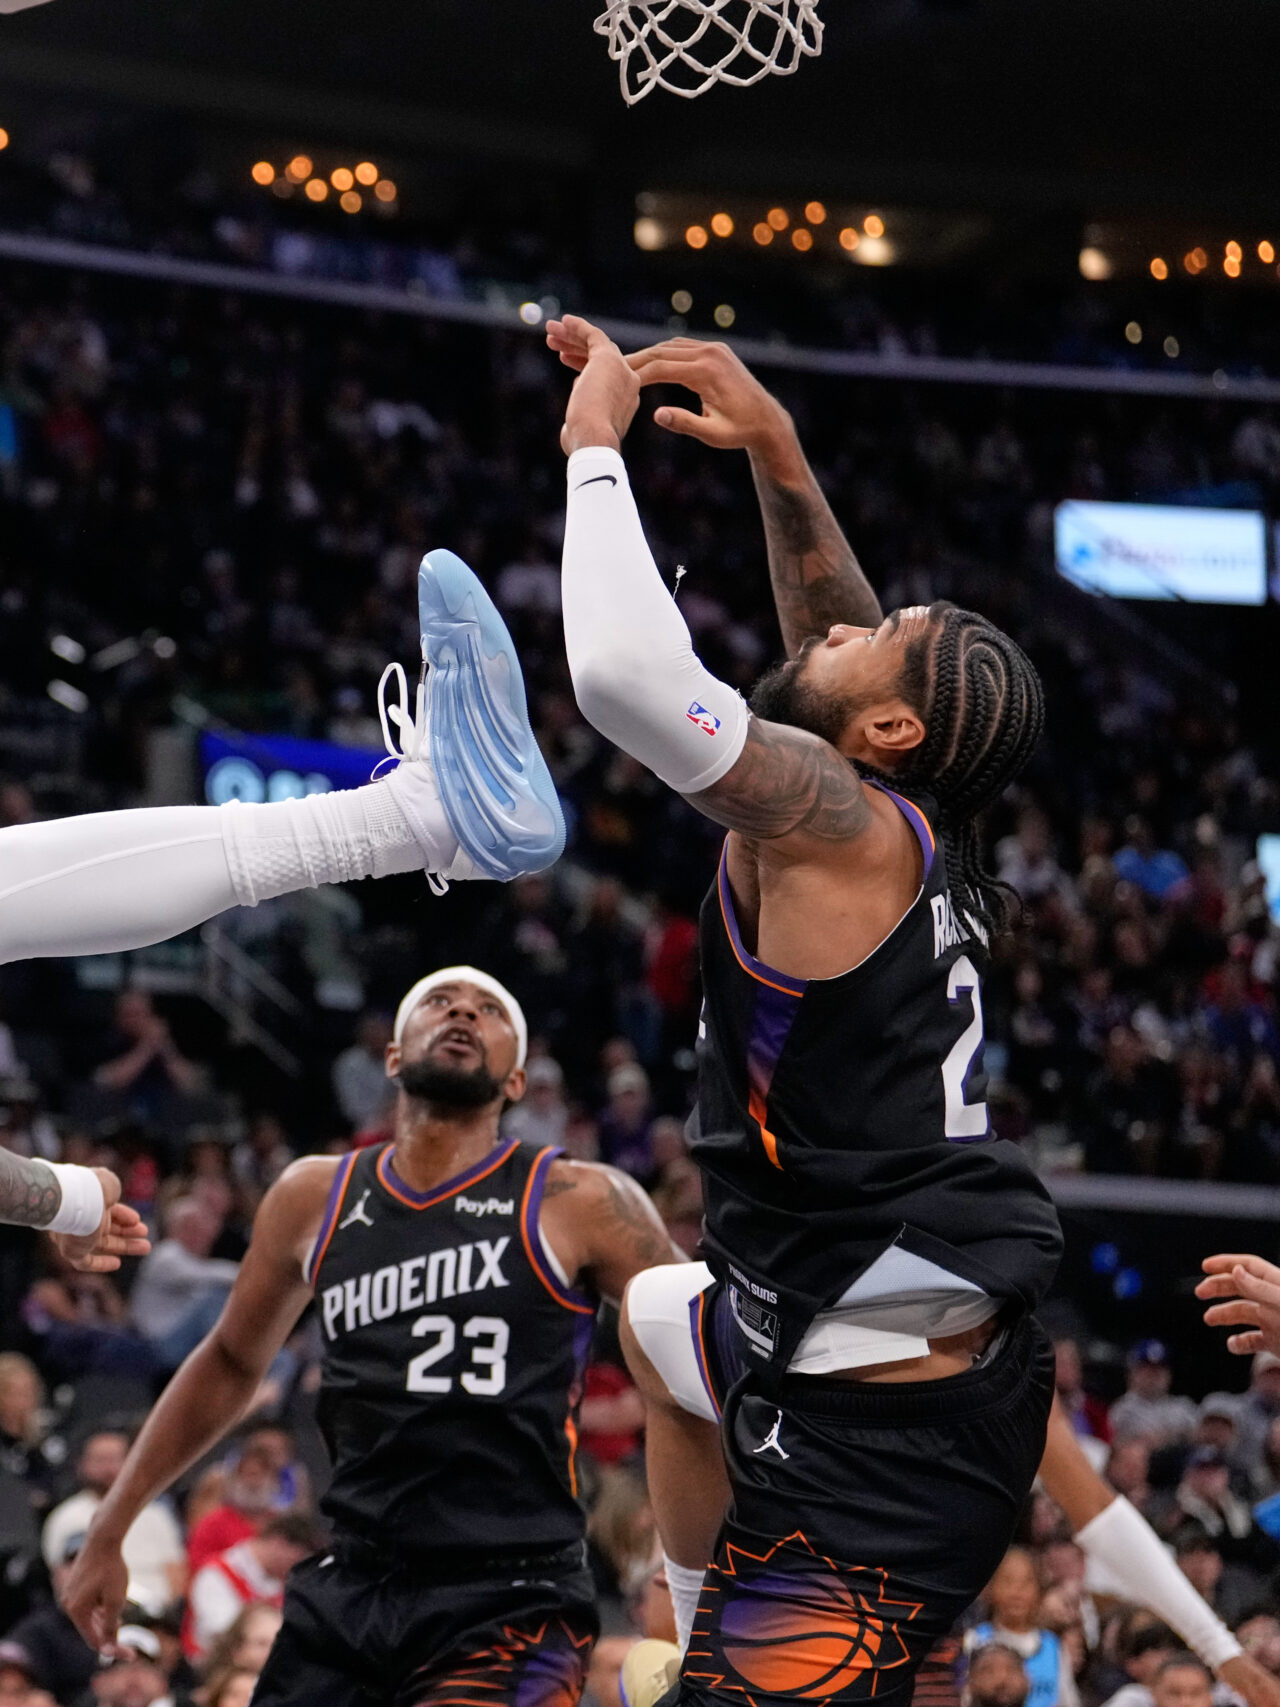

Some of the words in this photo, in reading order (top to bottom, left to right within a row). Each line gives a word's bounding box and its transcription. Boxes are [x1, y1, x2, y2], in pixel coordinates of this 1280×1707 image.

[941, 954, 990, 1140] 2
[455, 1195, 515, 1218] PayPal
[322, 1235, 511, 1342] PHOENIX
[406, 1314, 510, 1396] 23
